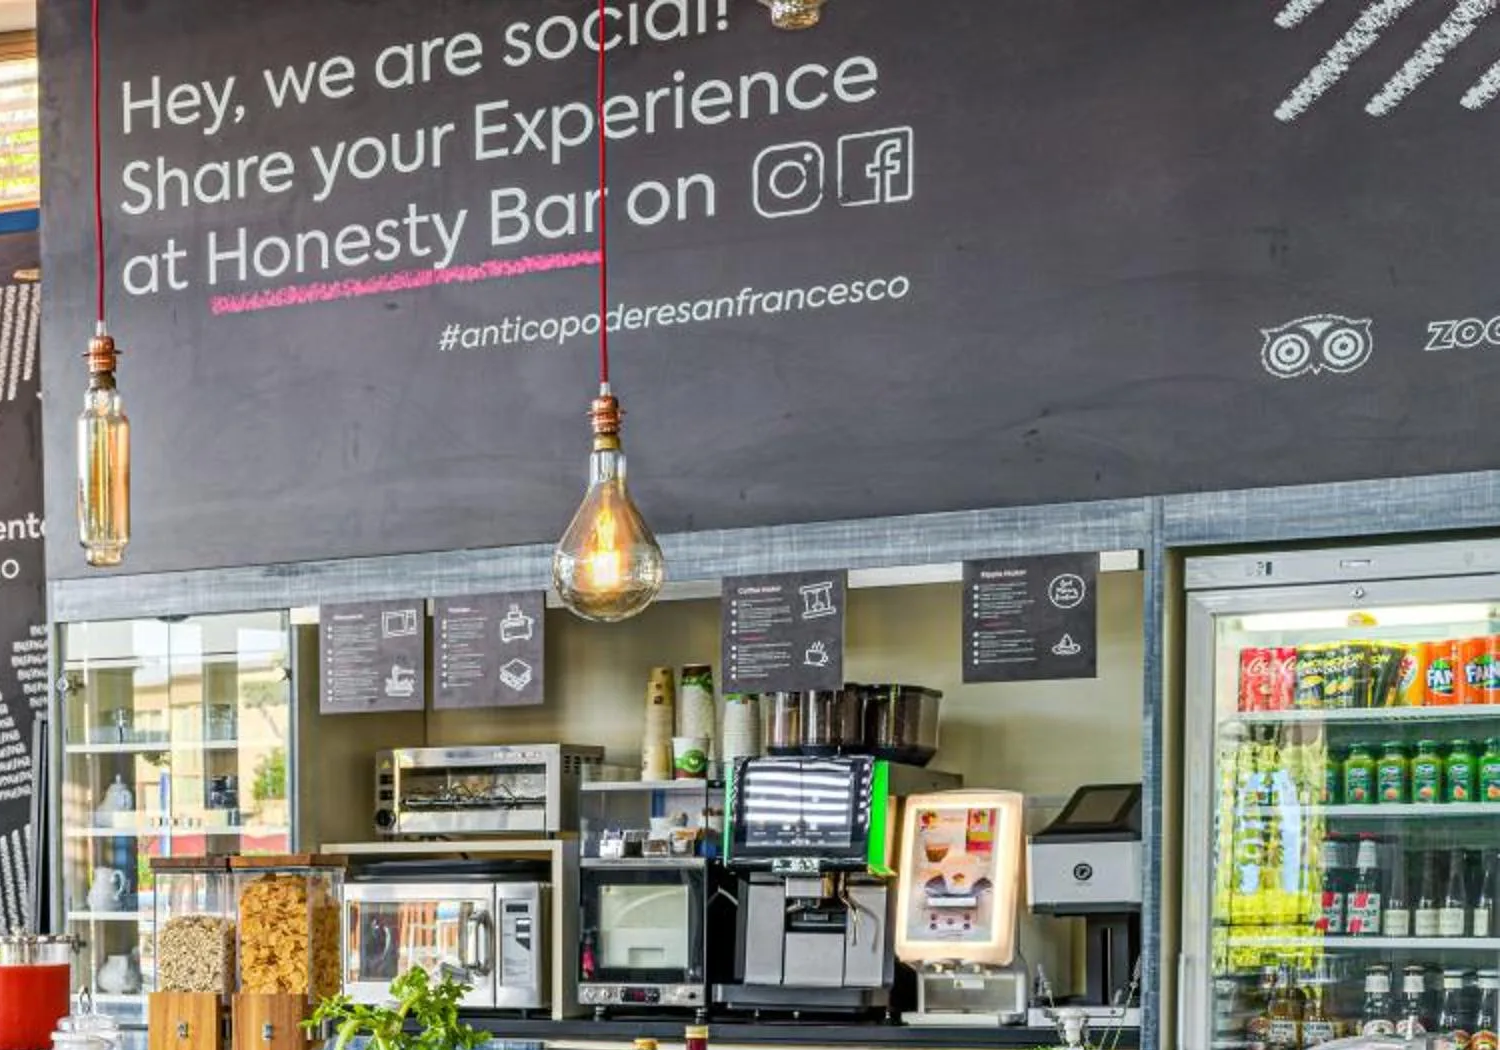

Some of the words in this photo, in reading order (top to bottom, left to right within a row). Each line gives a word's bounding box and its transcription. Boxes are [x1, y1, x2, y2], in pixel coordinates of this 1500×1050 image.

[119, 151, 295, 216] Share
[310, 122, 456, 203] your
[474, 55, 878, 165] Experience
[122, 75, 245, 136] Hey,
[263, 55, 356, 109] we
[375, 32, 483, 89] are
[121, 237, 190, 297] at
[206, 202, 469, 286] Honesty
[490, 186, 609, 248] Bar
[626, 173, 716, 226] on
[436, 275, 910, 353] #anticopoderesanfrancesco
